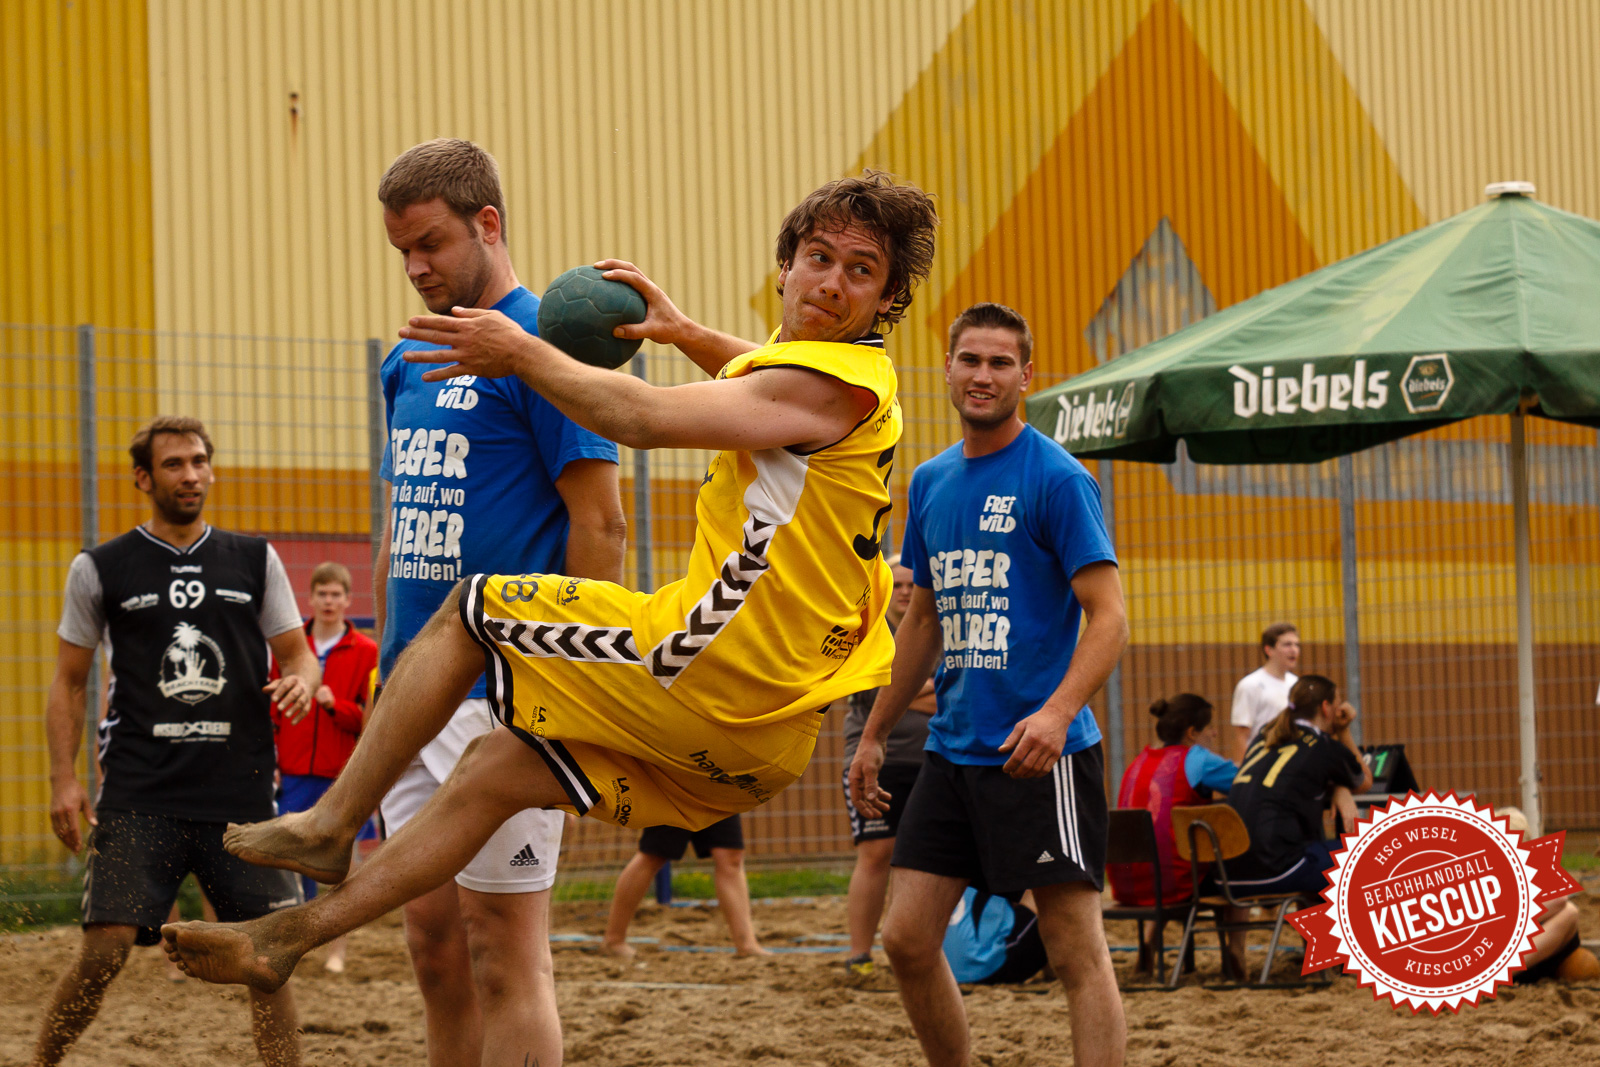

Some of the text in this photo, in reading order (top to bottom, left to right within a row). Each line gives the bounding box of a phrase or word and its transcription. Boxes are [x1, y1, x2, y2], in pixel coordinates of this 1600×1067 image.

[399, 480, 412, 502] da
[393, 556, 462, 581] bleiben!
[168, 579, 206, 609] 69
[1232, 740, 1299, 788] 21
